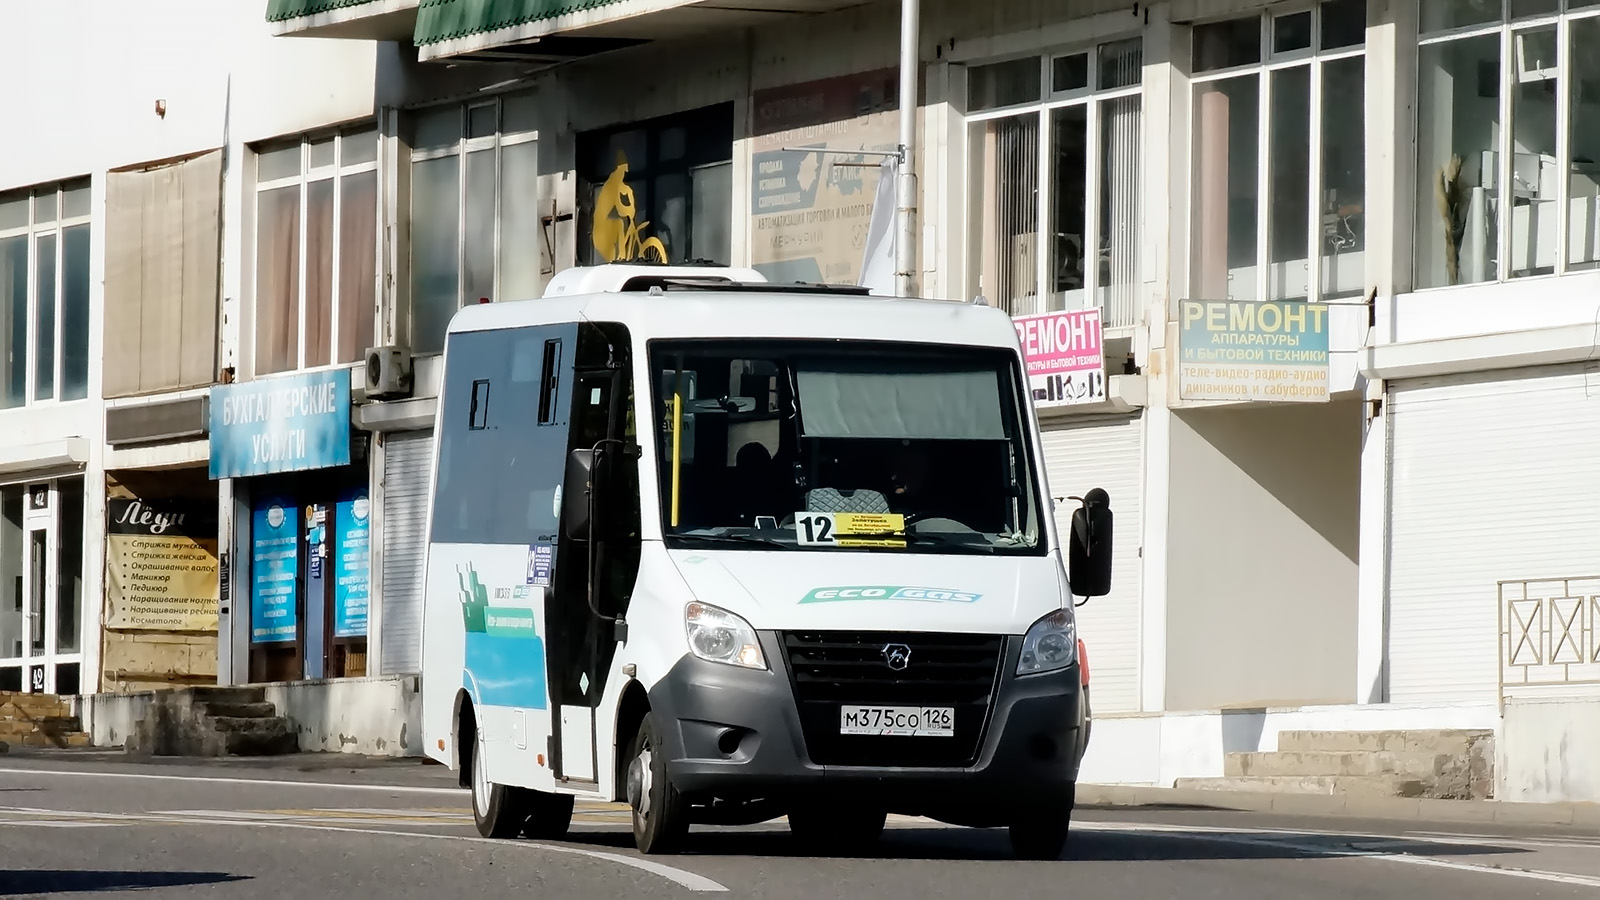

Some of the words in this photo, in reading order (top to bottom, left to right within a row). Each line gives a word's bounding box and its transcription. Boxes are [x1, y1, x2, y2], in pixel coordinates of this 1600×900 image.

[758, 213, 804, 230] АВТОМАТИЗАЦИЯ
[841, 204, 866, 219] МАЛОГО
[1184, 302, 1327, 333] РЕМОНТ
[1014, 312, 1098, 356] РЕМОНТ
[1211, 333, 1299, 346] АППАРАТУРЫ
[1185, 348, 1193, 359] И
[1198, 348, 1263, 361] БЫТОВОЙ
[1269, 350, 1326, 361] ТЕХНИКИ
[1051, 355, 1077, 369] БЫТОВОЙ
[1077, 354, 1100, 367] ТЕХНИКИ
[1184, 367, 1326, 382] теле-видео-радио-аудио
[1185, 384, 1248, 395] динамиков
[1253, 385, 1259, 394] и
[1264, 383, 1326, 397] сабуферов
[223, 382, 336, 426] БУХГАЛТЕРСКИЕ
[252, 429, 305, 464] УСЛУГИ
[799, 516, 833, 542] 12
[131, 540, 171, 550] Стрижка
[131, 551, 171, 561] Стрижка
[172, 552, 207, 560] женская
[131, 562, 189, 572] Окрашивание
[191, 564, 214, 572] волос
[131, 573, 170, 583] Маникюр
[130, 584, 168, 593] Педикюр
[814, 588, 886, 599] ECO
[130, 595, 189, 604] Наращивание
[130, 605, 188, 615] Наращивание
[130, 616, 182, 625] Косметолог
[33, 668, 43, 689] 42
[923, 709, 951, 724] 126
